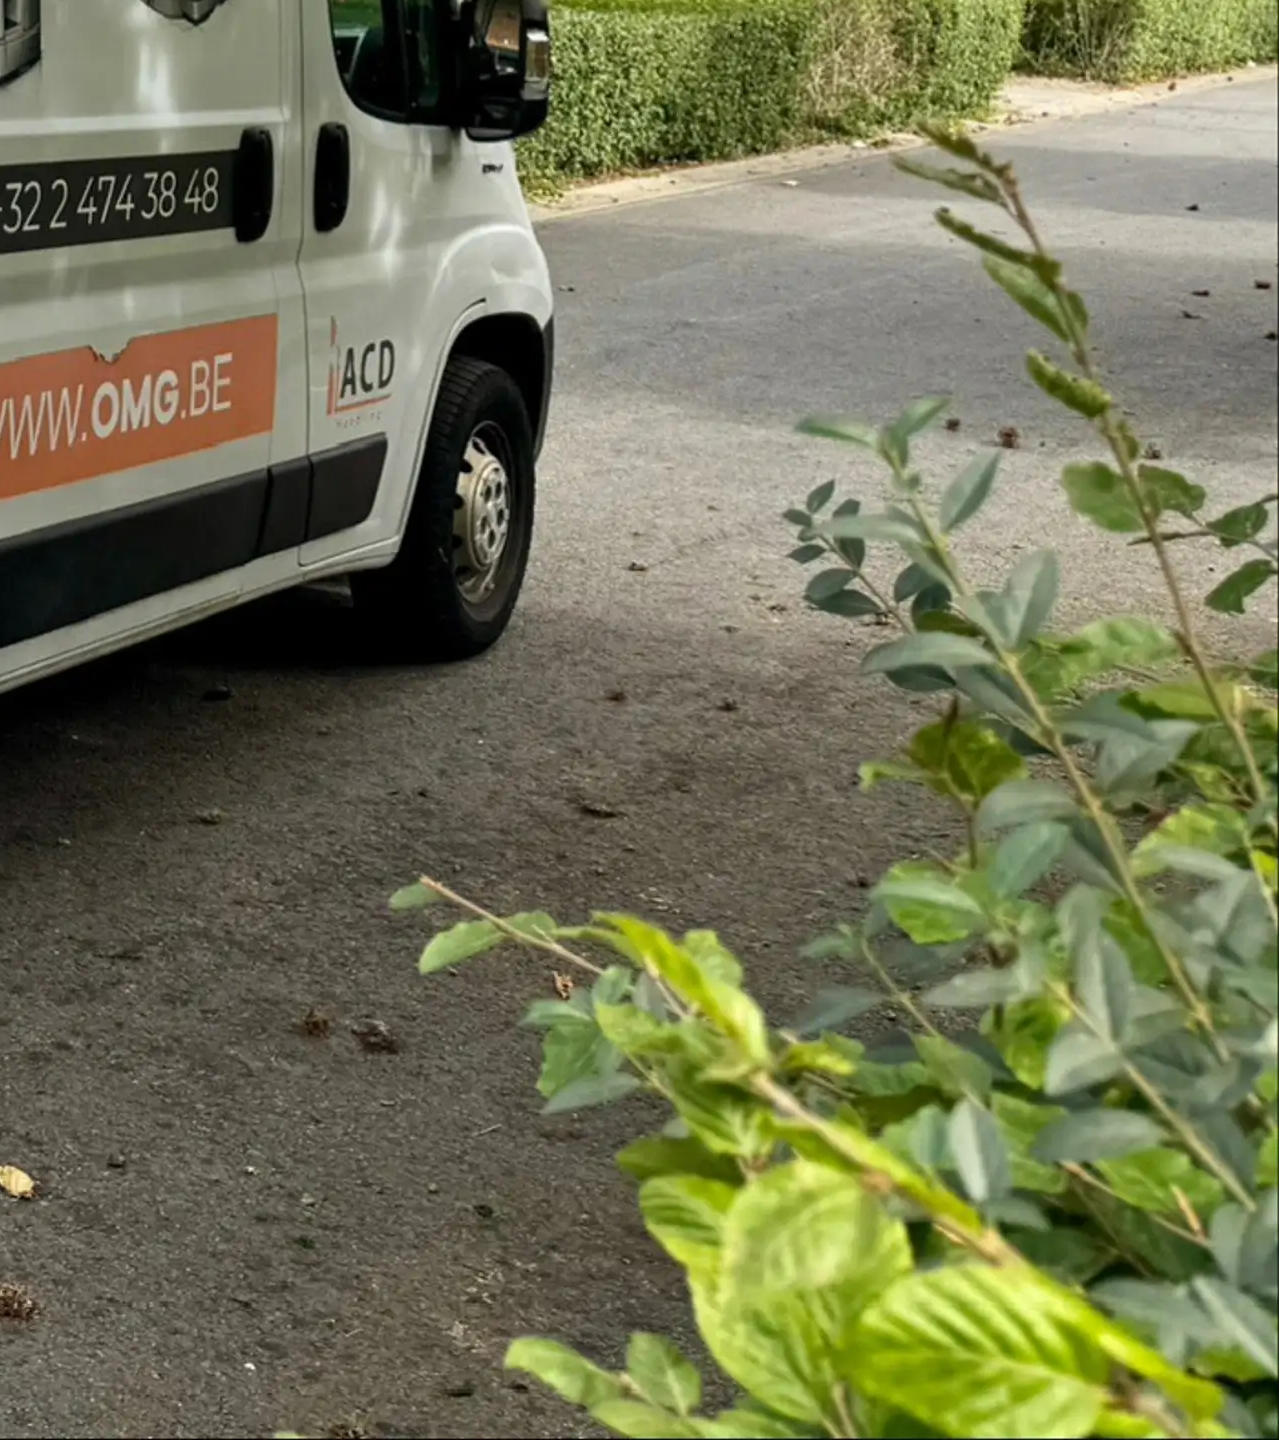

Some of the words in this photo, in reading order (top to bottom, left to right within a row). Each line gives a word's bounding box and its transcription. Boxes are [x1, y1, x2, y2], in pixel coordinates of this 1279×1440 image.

[49, 178, 69, 229] 2
[76, 173, 136, 225] 474
[141, 170, 177, 220] 38
[183, 167, 220, 215] 48
[339, 339, 395, 399] ACD
